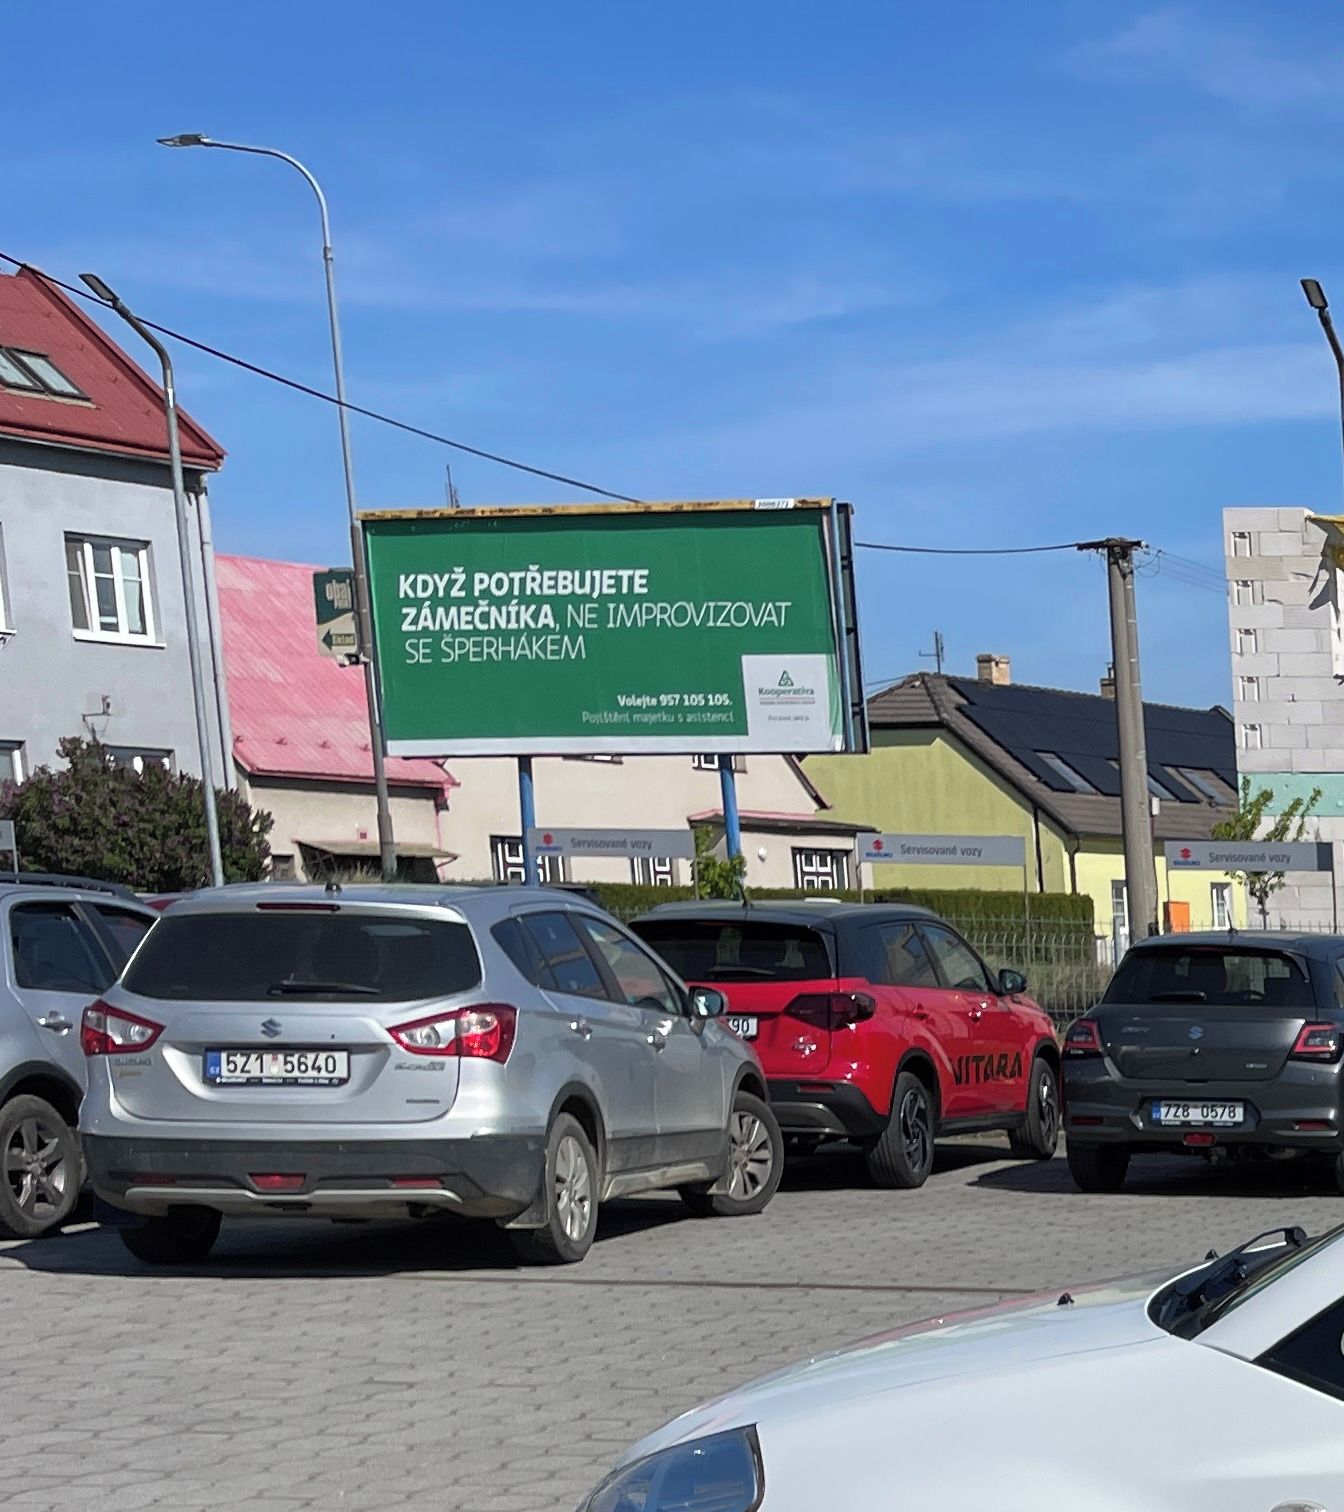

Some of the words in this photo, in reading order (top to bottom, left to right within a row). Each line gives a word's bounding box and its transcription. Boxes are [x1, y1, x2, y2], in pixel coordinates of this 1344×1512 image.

[399, 566, 466, 598] KDYŽ
[473, 564, 649, 599] POTŘEBUJETE
[401, 599, 560, 632] ZÁMEČNÍKA,
[567, 603, 599, 628] NE
[606, 601, 792, 628] IMPROVIZOVAT
[405, 638, 432, 664] SE
[441, 632, 586, 663] ŠPERHÁKEM
[616, 694, 657, 709] Volejte
[659, 693, 680, 707] 957
[683, 693, 705, 707] 105
[707, 693, 733, 706] 105.
[900, 843, 957, 856] Servisované
[960, 847, 982, 858] vozy
[1208, 852, 1266, 863] Servisované
[1269, 854, 1291, 864] vozy
[226, 1053, 265, 1073] 5Z1
[283, 1053, 337, 1074] 5640
[953, 1052, 1022, 1085] VITARA
[1164, 1103, 1190, 1118] 7Z8
[1200, 1103, 1237, 1119] 0578
